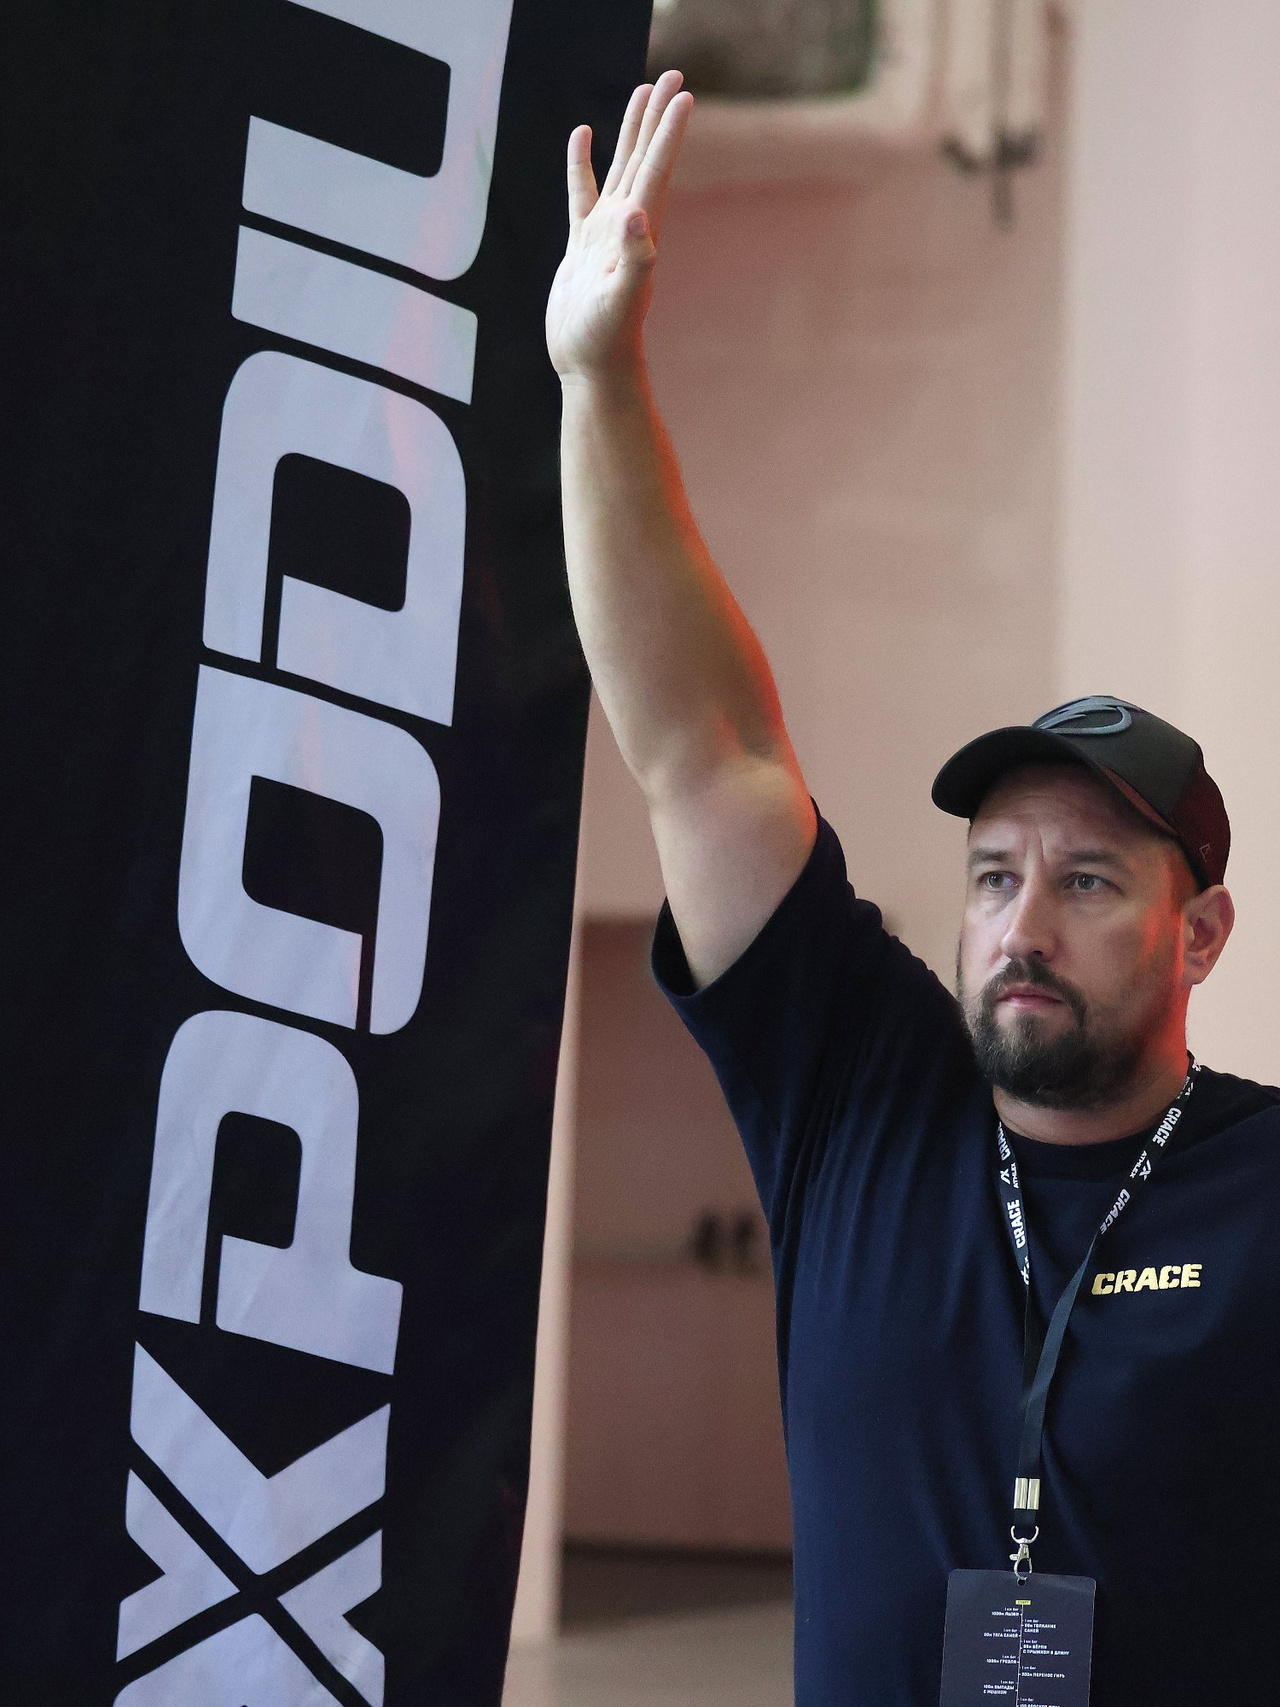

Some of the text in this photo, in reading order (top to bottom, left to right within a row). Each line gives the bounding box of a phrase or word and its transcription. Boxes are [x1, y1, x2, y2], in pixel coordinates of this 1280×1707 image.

[1152, 1107, 1182, 1147] CRACE
[1010, 1162, 1019, 1189] ATHLEX
[1129, 1150, 1147, 1179] ATHLEX
[1007, 1199, 1026, 1249] CRACE
[1099, 1188, 1131, 1235] CRACE
[1091, 1263, 1203, 1296] CRACE
